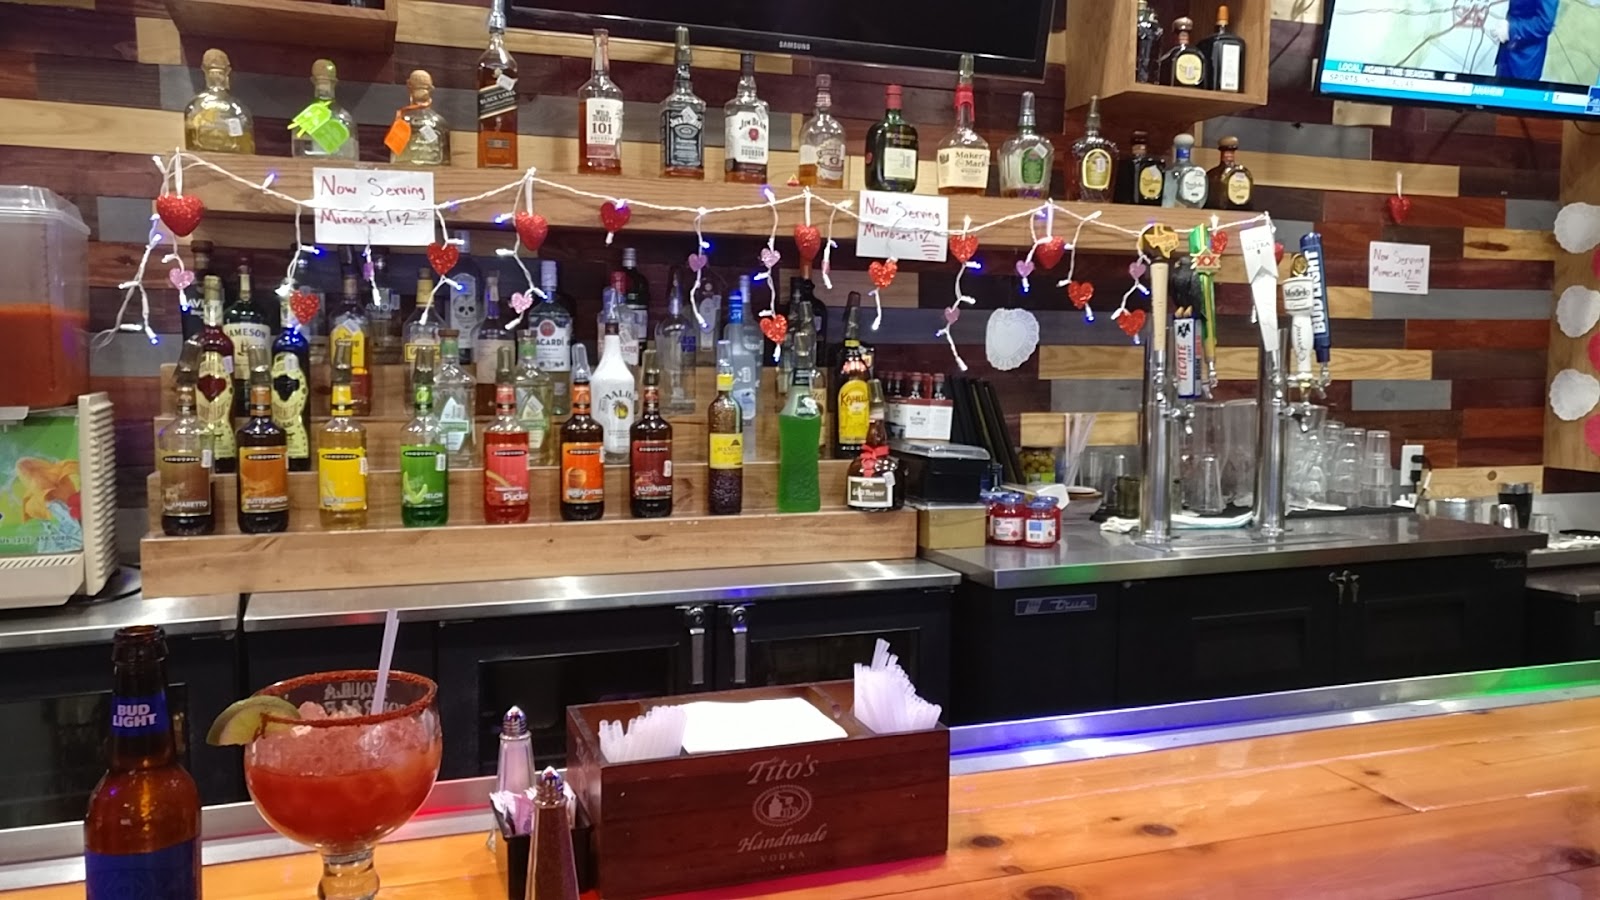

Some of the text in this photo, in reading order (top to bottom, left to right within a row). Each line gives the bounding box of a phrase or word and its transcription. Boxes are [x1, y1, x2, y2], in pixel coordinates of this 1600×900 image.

[779, 41, 810, 50] SAMSUNG
[1338, 62, 1361, 73] LOCAL
[480, 90, 516, 105] BLACK LABEL
[592, 122, 612, 134] 101
[739, 117, 767, 131] JIM BEAM
[741, 148, 764, 157] BOURBON
[965, 160, 986, 168] Mark
[320, 175, 426, 201] Now Serving
[865, 197, 941, 227] Now Serving
[1245, 242, 1271, 251] ULTRA
[1374, 248, 1424, 269] Now Serving
[1284, 287, 1311, 297] Modelo
[1311, 297, 1327, 334] BUD
[1177, 344, 1188, 382] TECATE
[841, 393, 871, 407] KAHL
[1050, 597, 1090, 611] True
[117, 704, 150, 716] BUD
[112, 713, 158, 728] LIGHT
[747, 754, 819, 785] Tito's
[737, 823, 828, 853] Handmade
[760, 851, 805, 863] VODKA
